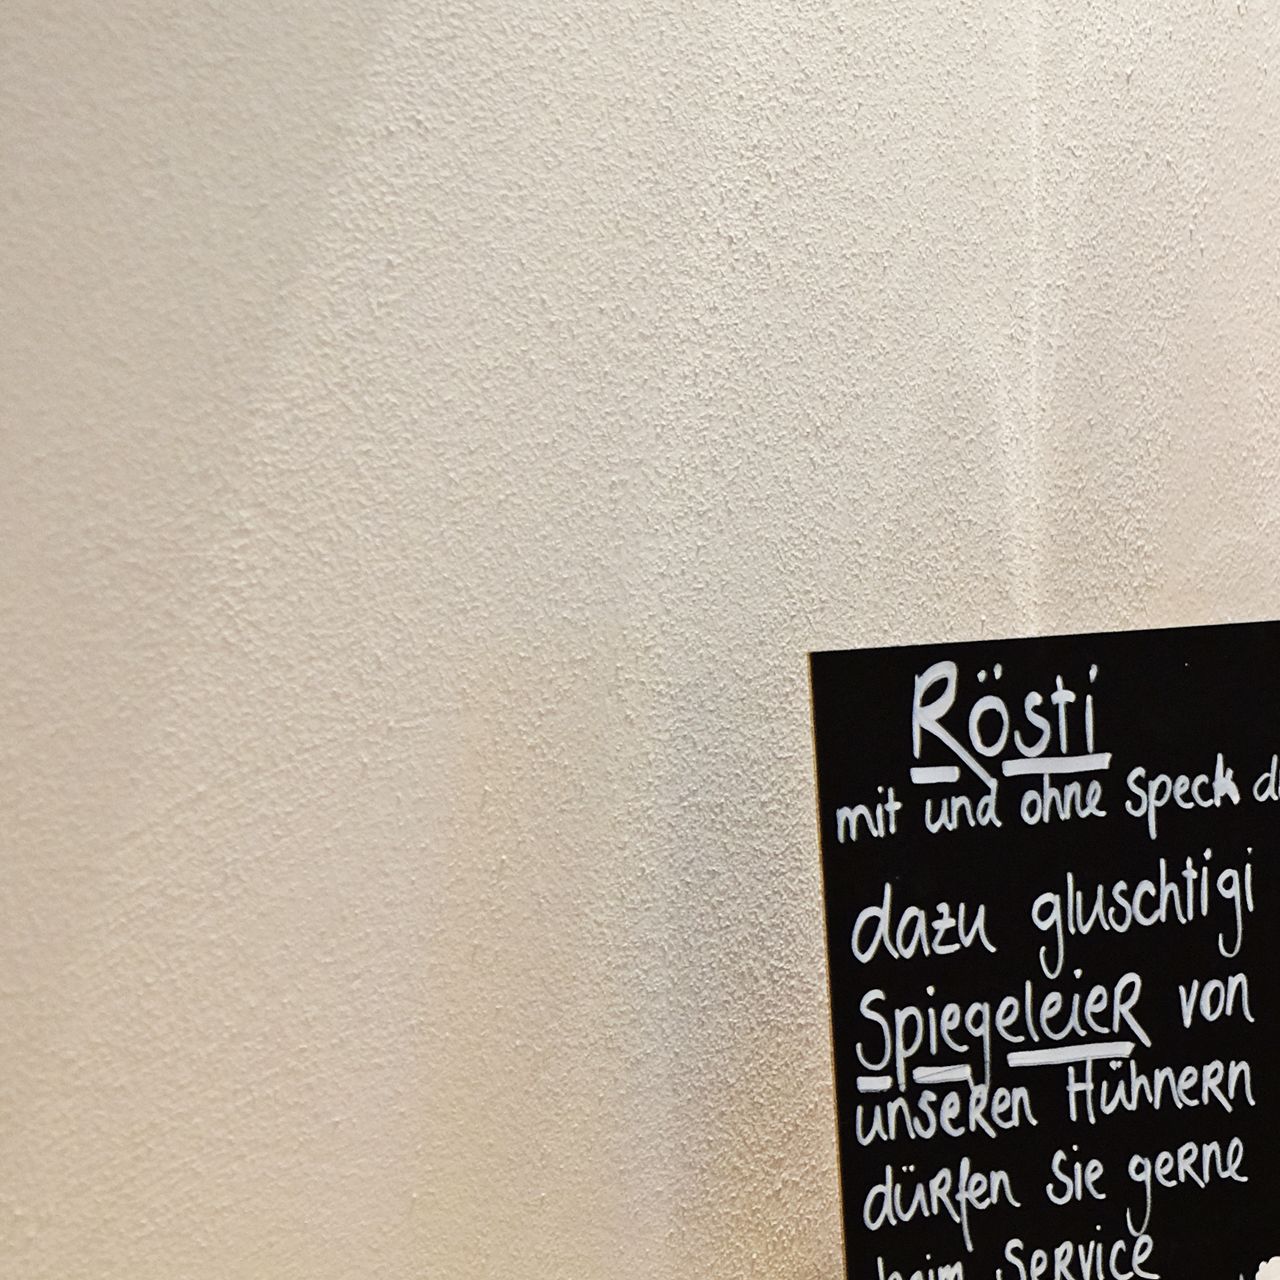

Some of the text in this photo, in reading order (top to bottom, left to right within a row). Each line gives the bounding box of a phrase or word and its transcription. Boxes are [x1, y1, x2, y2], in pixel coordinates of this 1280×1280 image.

[912, 660, 1099, 787] Rösti
[836, 786, 902, 844] mit
[925, 786, 1002, 834] und
[1020, 773, 1106, 826] ohne
[1125, 752, 1241, 840] Speck
[851, 882, 997, 964] dazu
[1179, 972, 1255, 1029] von
[1046, 1144, 1106, 1205] Sie
